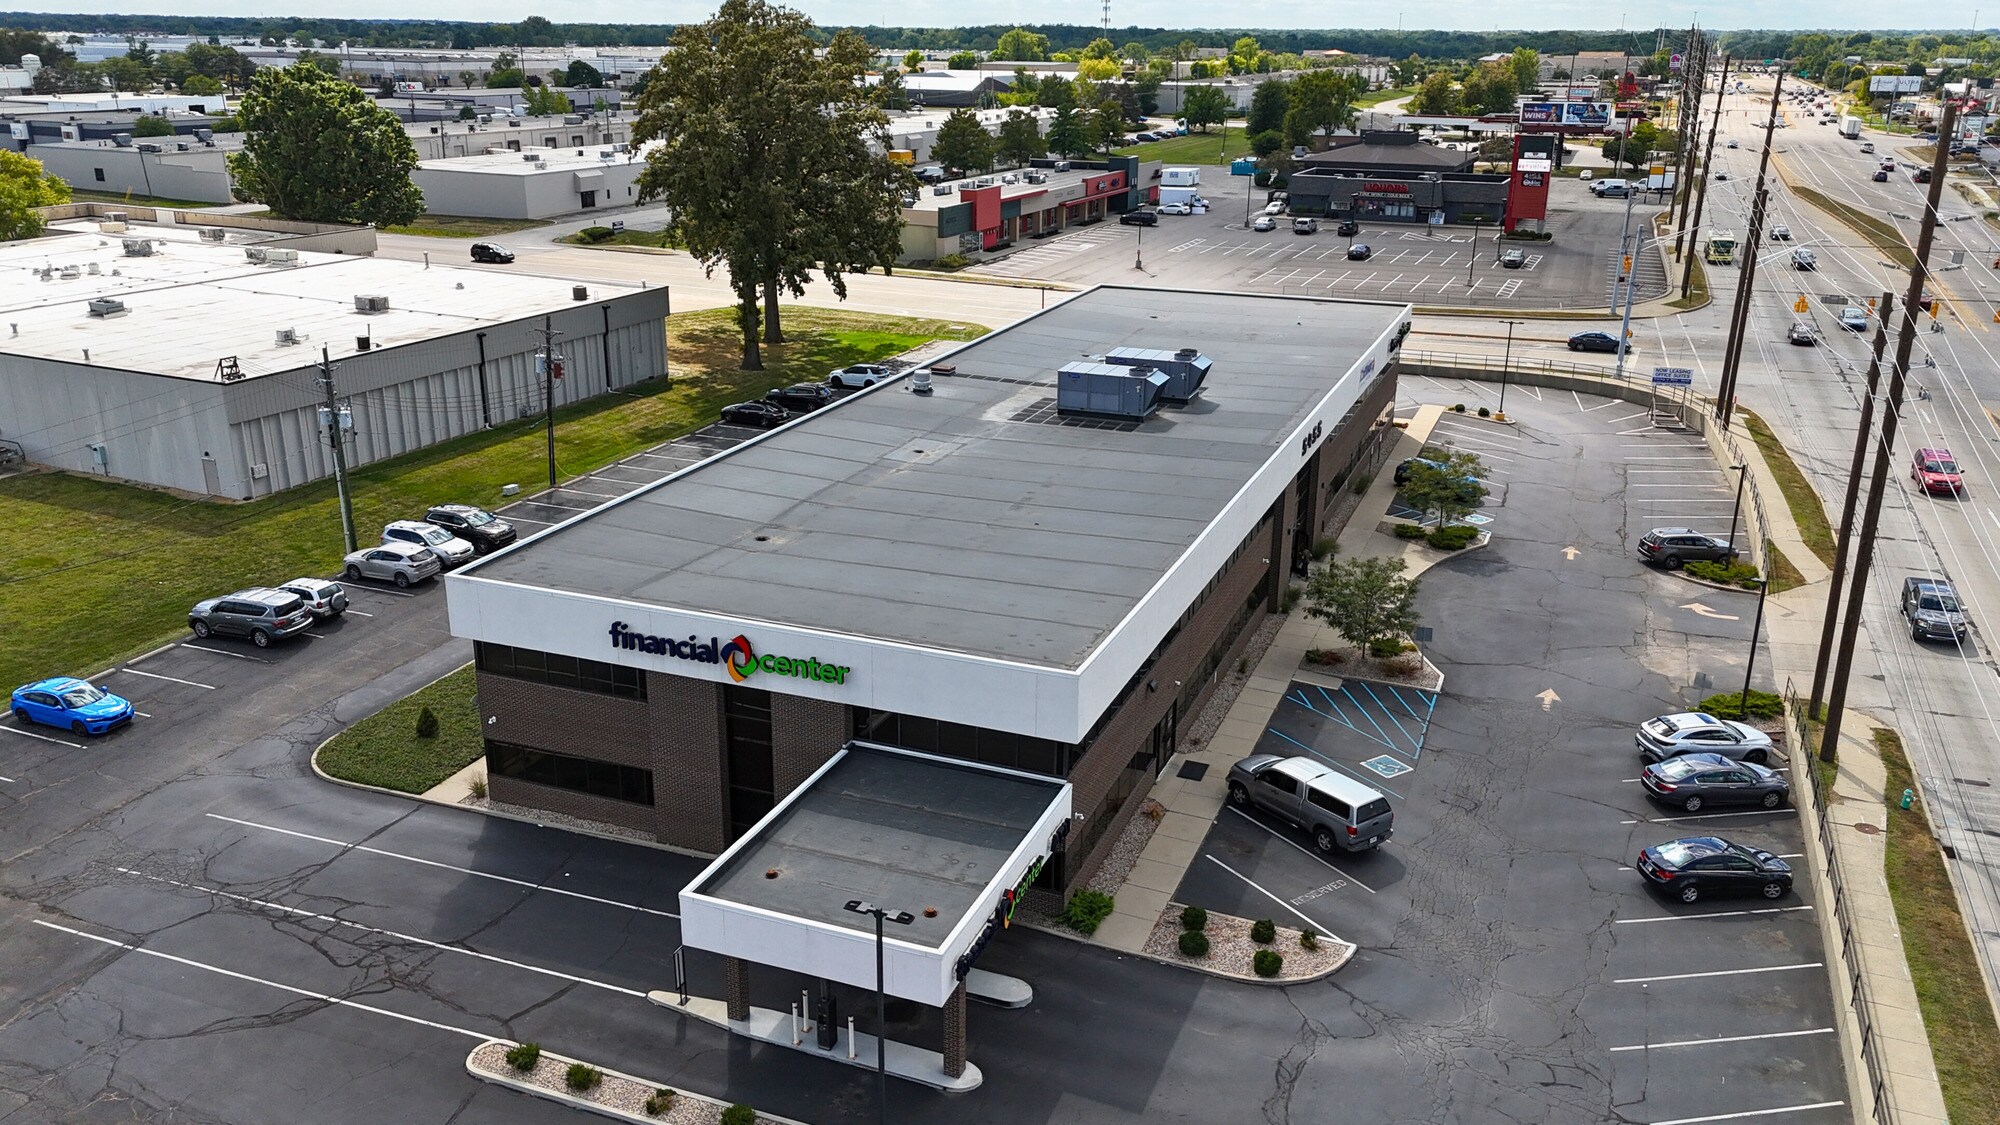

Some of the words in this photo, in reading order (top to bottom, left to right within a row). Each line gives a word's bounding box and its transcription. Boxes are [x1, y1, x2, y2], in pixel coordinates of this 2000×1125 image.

[1364, 182, 1408, 193] LIQUORS
[608, 621, 719, 664] financial
[759, 653, 850, 685] center
[1013, 855, 1044, 904] cente
[1290, 879, 1347, 906] RESERVED
